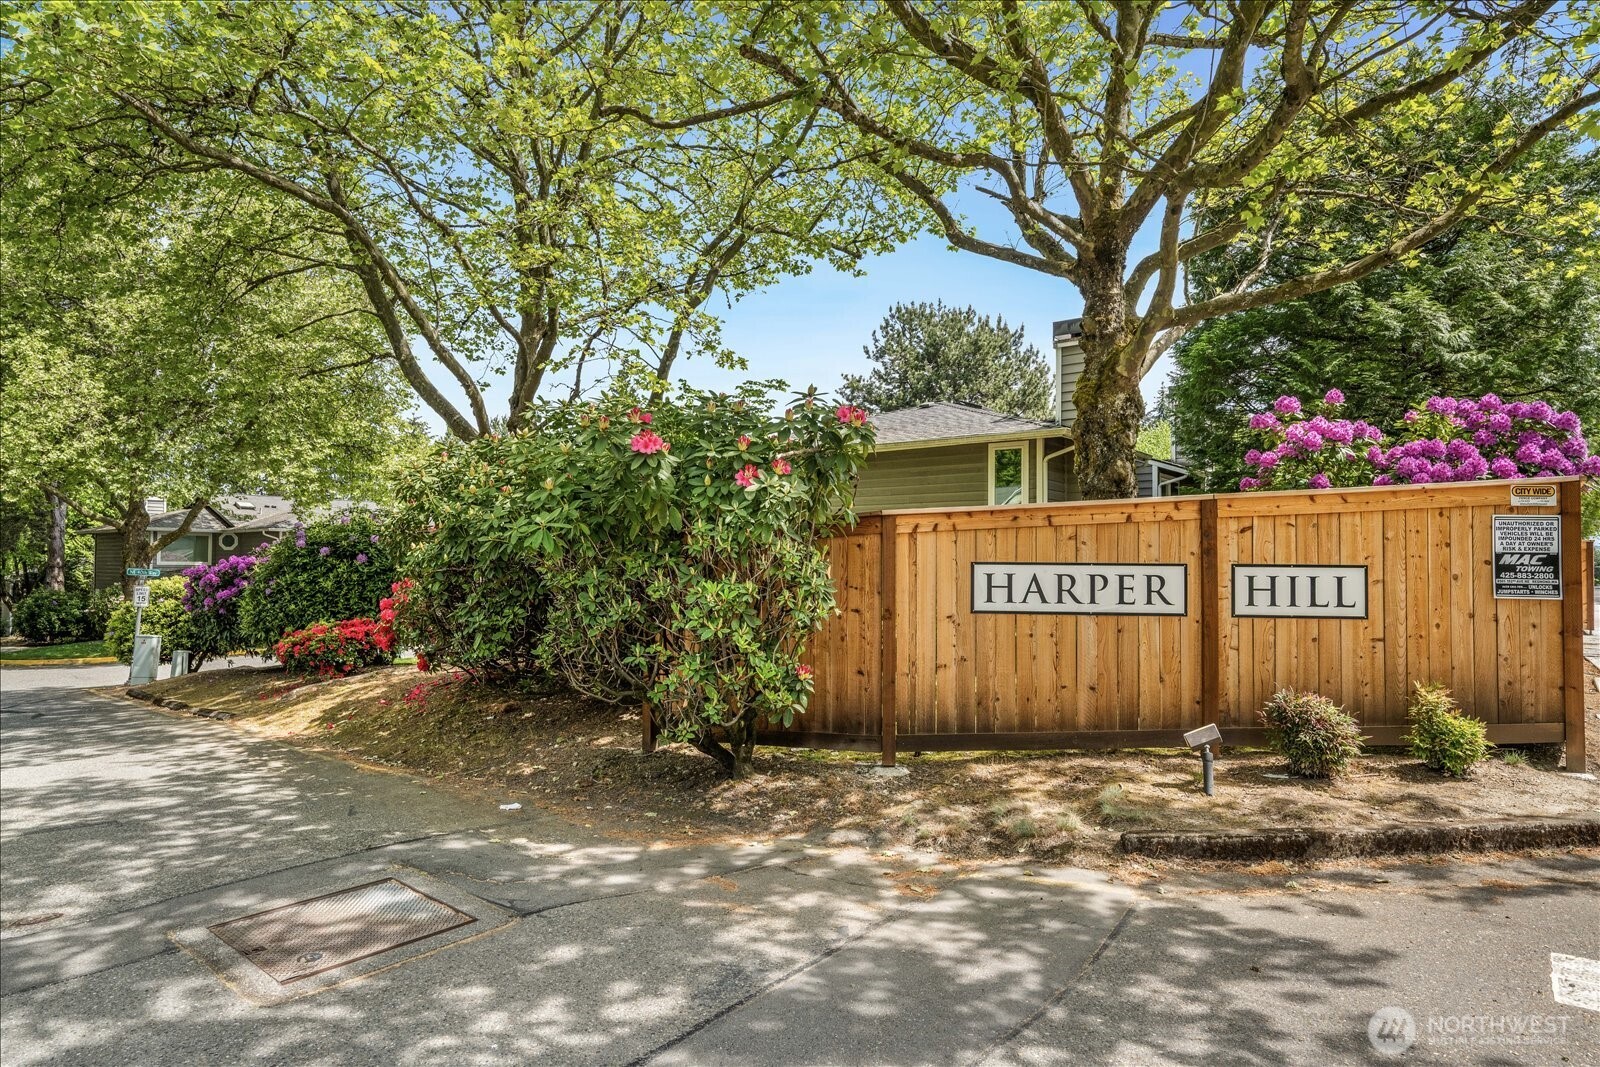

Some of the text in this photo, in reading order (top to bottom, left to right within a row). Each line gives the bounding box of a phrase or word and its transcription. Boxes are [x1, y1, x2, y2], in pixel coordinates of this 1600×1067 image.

[1498, 554, 1548, 565] MAC
[983, 572, 1357, 608] HARPER HILL
